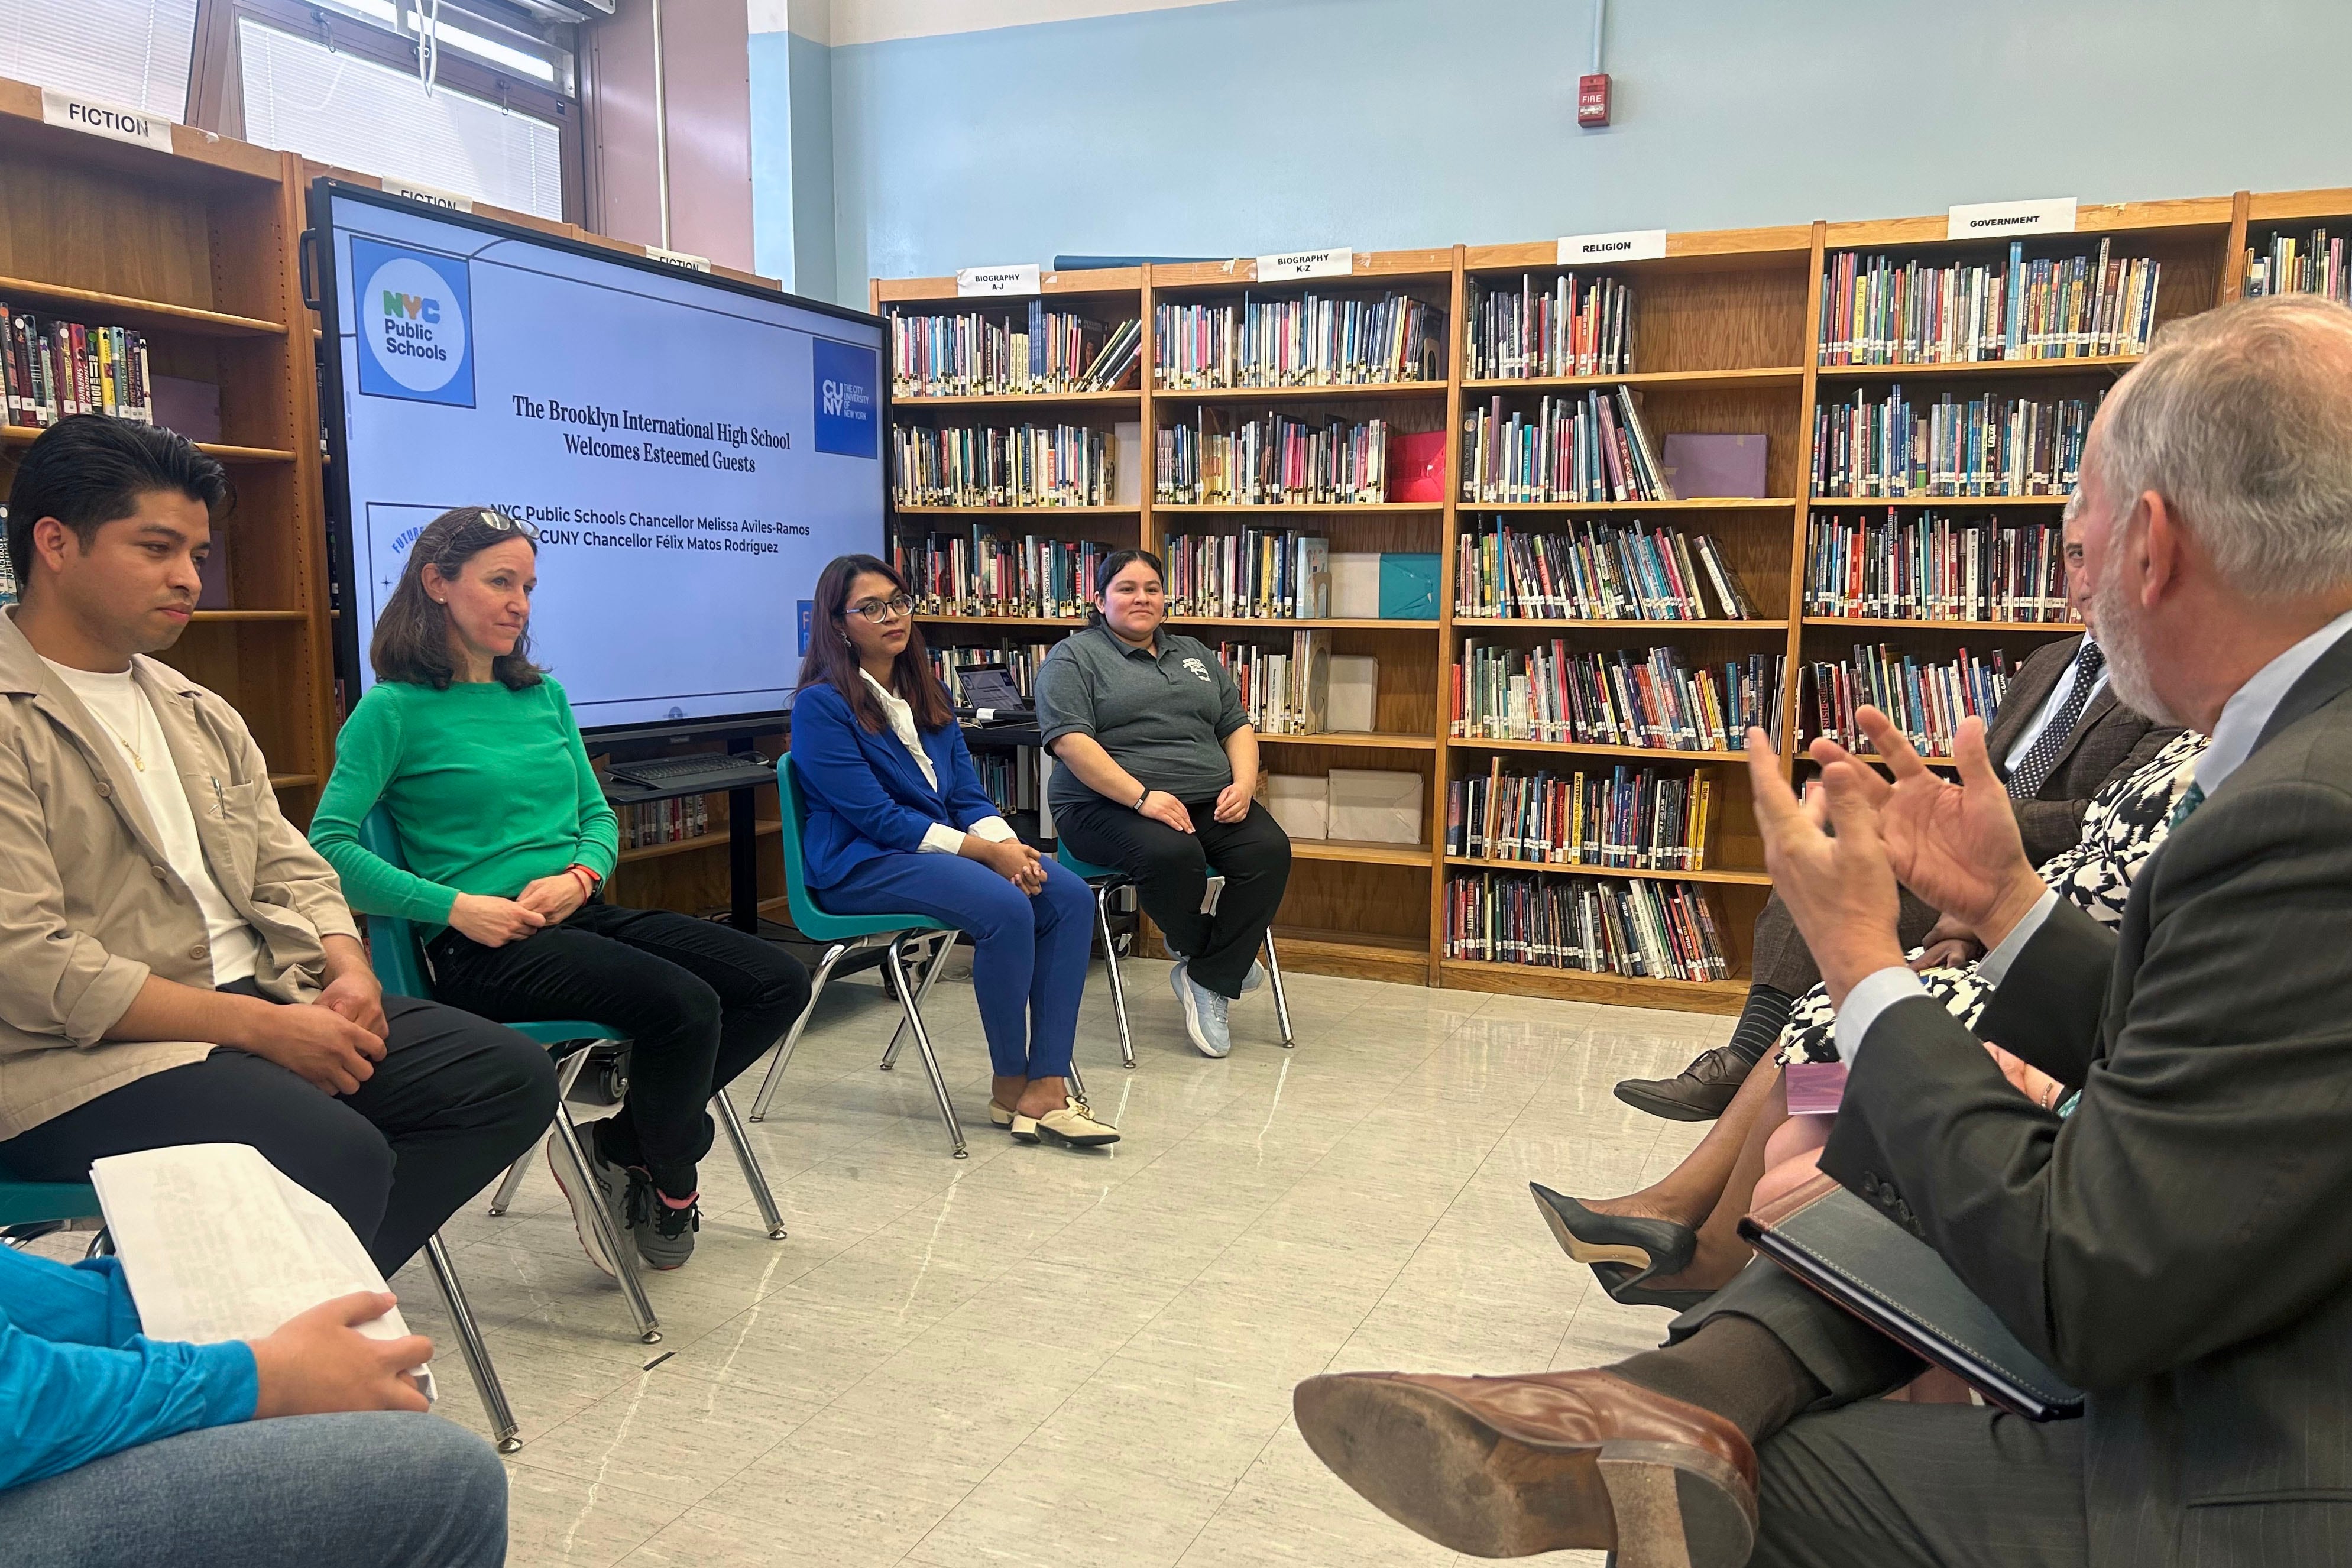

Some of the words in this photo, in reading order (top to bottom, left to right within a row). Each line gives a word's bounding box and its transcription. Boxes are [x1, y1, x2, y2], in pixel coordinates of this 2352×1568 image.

[1582, 95, 1602, 103] FIRE
[69, 103, 149, 137] FICTION
[1969, 215, 2040, 228] GOVERNMENT
[1582, 241, 1631, 253] RELIGION
[1277, 253, 1329, 265] BIOGRAPHY
[975, 274, 1020, 282] BIOGRAPHY
[383, 289, 440, 325] NYC
[385, 318, 433, 341] Public
[386, 336, 447, 361] Schools
[89, 362, 99, 377] IT
[91, 385, 103, 407] DOWN
[844, 383, 853, 393] THE
[853, 385, 863, 395] CITY
[843, 392, 869, 405] UNIVERSITY
[844, 401, 851, 409] OF
[512, 394, 545, 419] The
[548, 400, 620, 432] Brooklyn
[622, 410, 715, 440] International
[717, 422, 749, 448] High
[751, 427, 791, 449] School
[844, 409, 854, 419] NEW
[855, 411, 867, 421] YORK
[563, 433, 640, 461] Welcomes
[643, 442, 710, 468] Esteemed
[712, 451, 756, 473] Guests
[526, 506, 571, 522] Public
[574, 508, 626, 526] Schools
[629, 512, 694, 530] Chancellor
[697, 517, 738, 532] Melissa
[741, 520, 811, 536] Aviles-Ramos
[539, 530, 579, 545] CUNY
[583, 531, 653, 548] Chancellor
[656, 534, 684, 550] Félix
[687, 536, 721, 551] Matos
[724, 539, 779, 556] Rodríguez
[1684, 935, 1693, 949] WIDE
